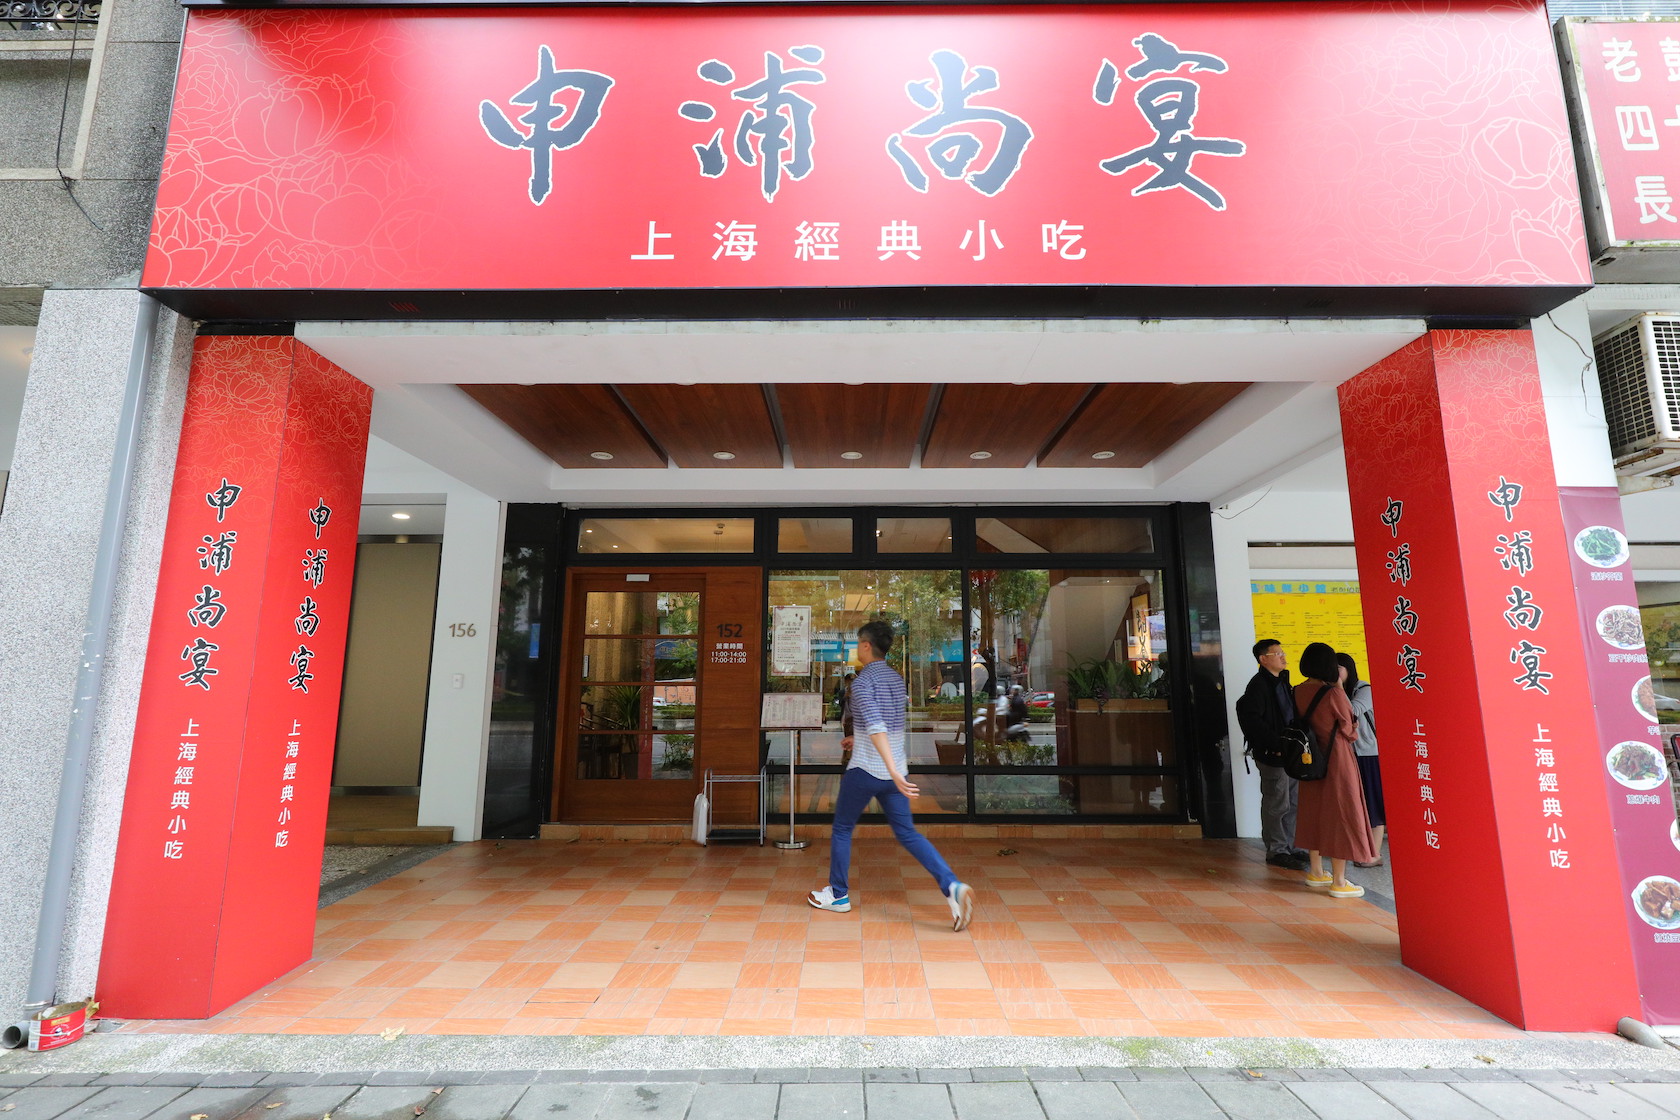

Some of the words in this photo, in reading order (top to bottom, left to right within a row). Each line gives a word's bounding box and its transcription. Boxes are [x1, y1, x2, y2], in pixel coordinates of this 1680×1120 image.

[478, 32, 1247, 211] 申浦尚宴
[631, 219, 1087, 262] 上海經典小吃
[179, 477, 242, 691] 申浦尚宴
[288, 497, 332, 695] 申浦尚宴
[449, 623, 477, 637] 156
[717, 624, 743, 638] 152
[1380, 495, 1425, 694] 申浦尚宴
[1487, 475, 1552, 696] 申浦尚宴
[164, 718, 199, 859] 上海經典小吃
[275, 718, 301, 848] 上海經典小吃
[1412, 718, 1440, 850] 上海經典小吃
[1532, 722, 1571, 869] 上海經典小吃
